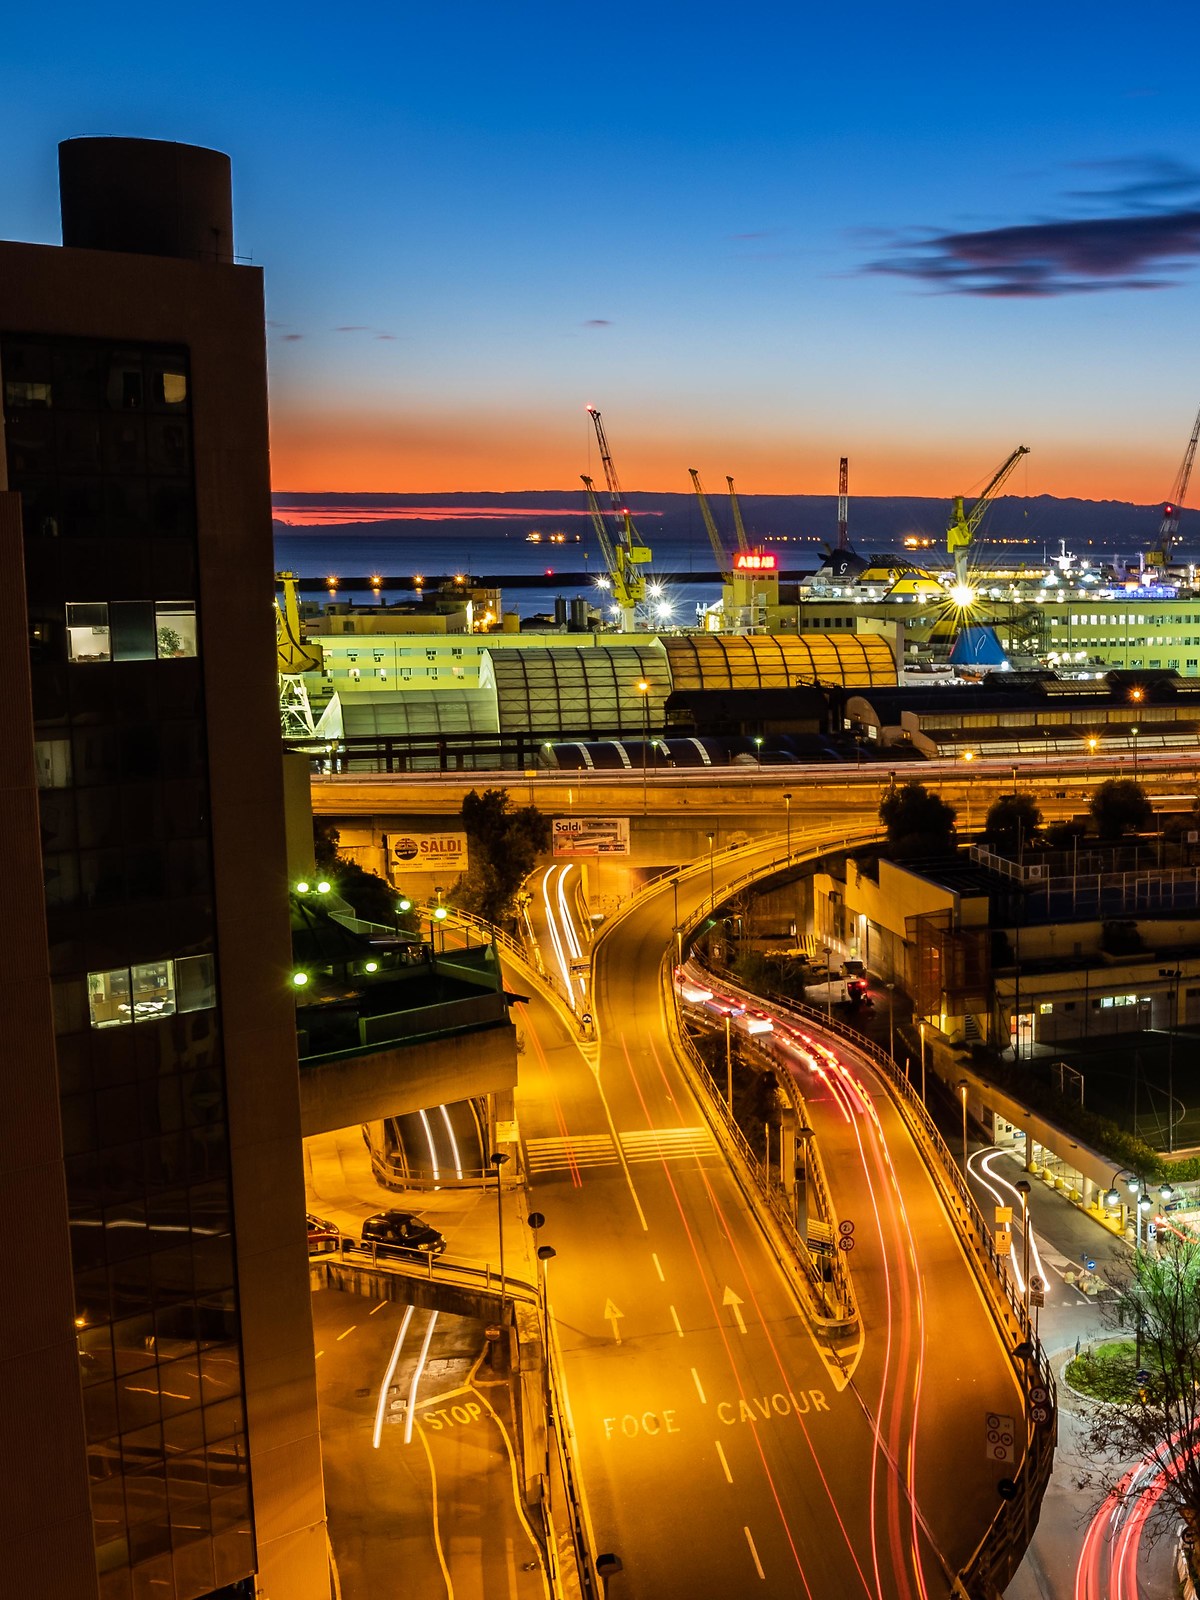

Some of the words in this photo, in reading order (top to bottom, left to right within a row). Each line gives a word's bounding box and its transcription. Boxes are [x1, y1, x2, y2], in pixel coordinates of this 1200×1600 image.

[555, 822, 581, 832] Saldi
[420, 840, 462, 853] SALDI
[423, 1402, 482, 1430] STOP
[603, 1410, 681, 1440] FOCE
[717, 1389, 831, 1425] CAVOUR
